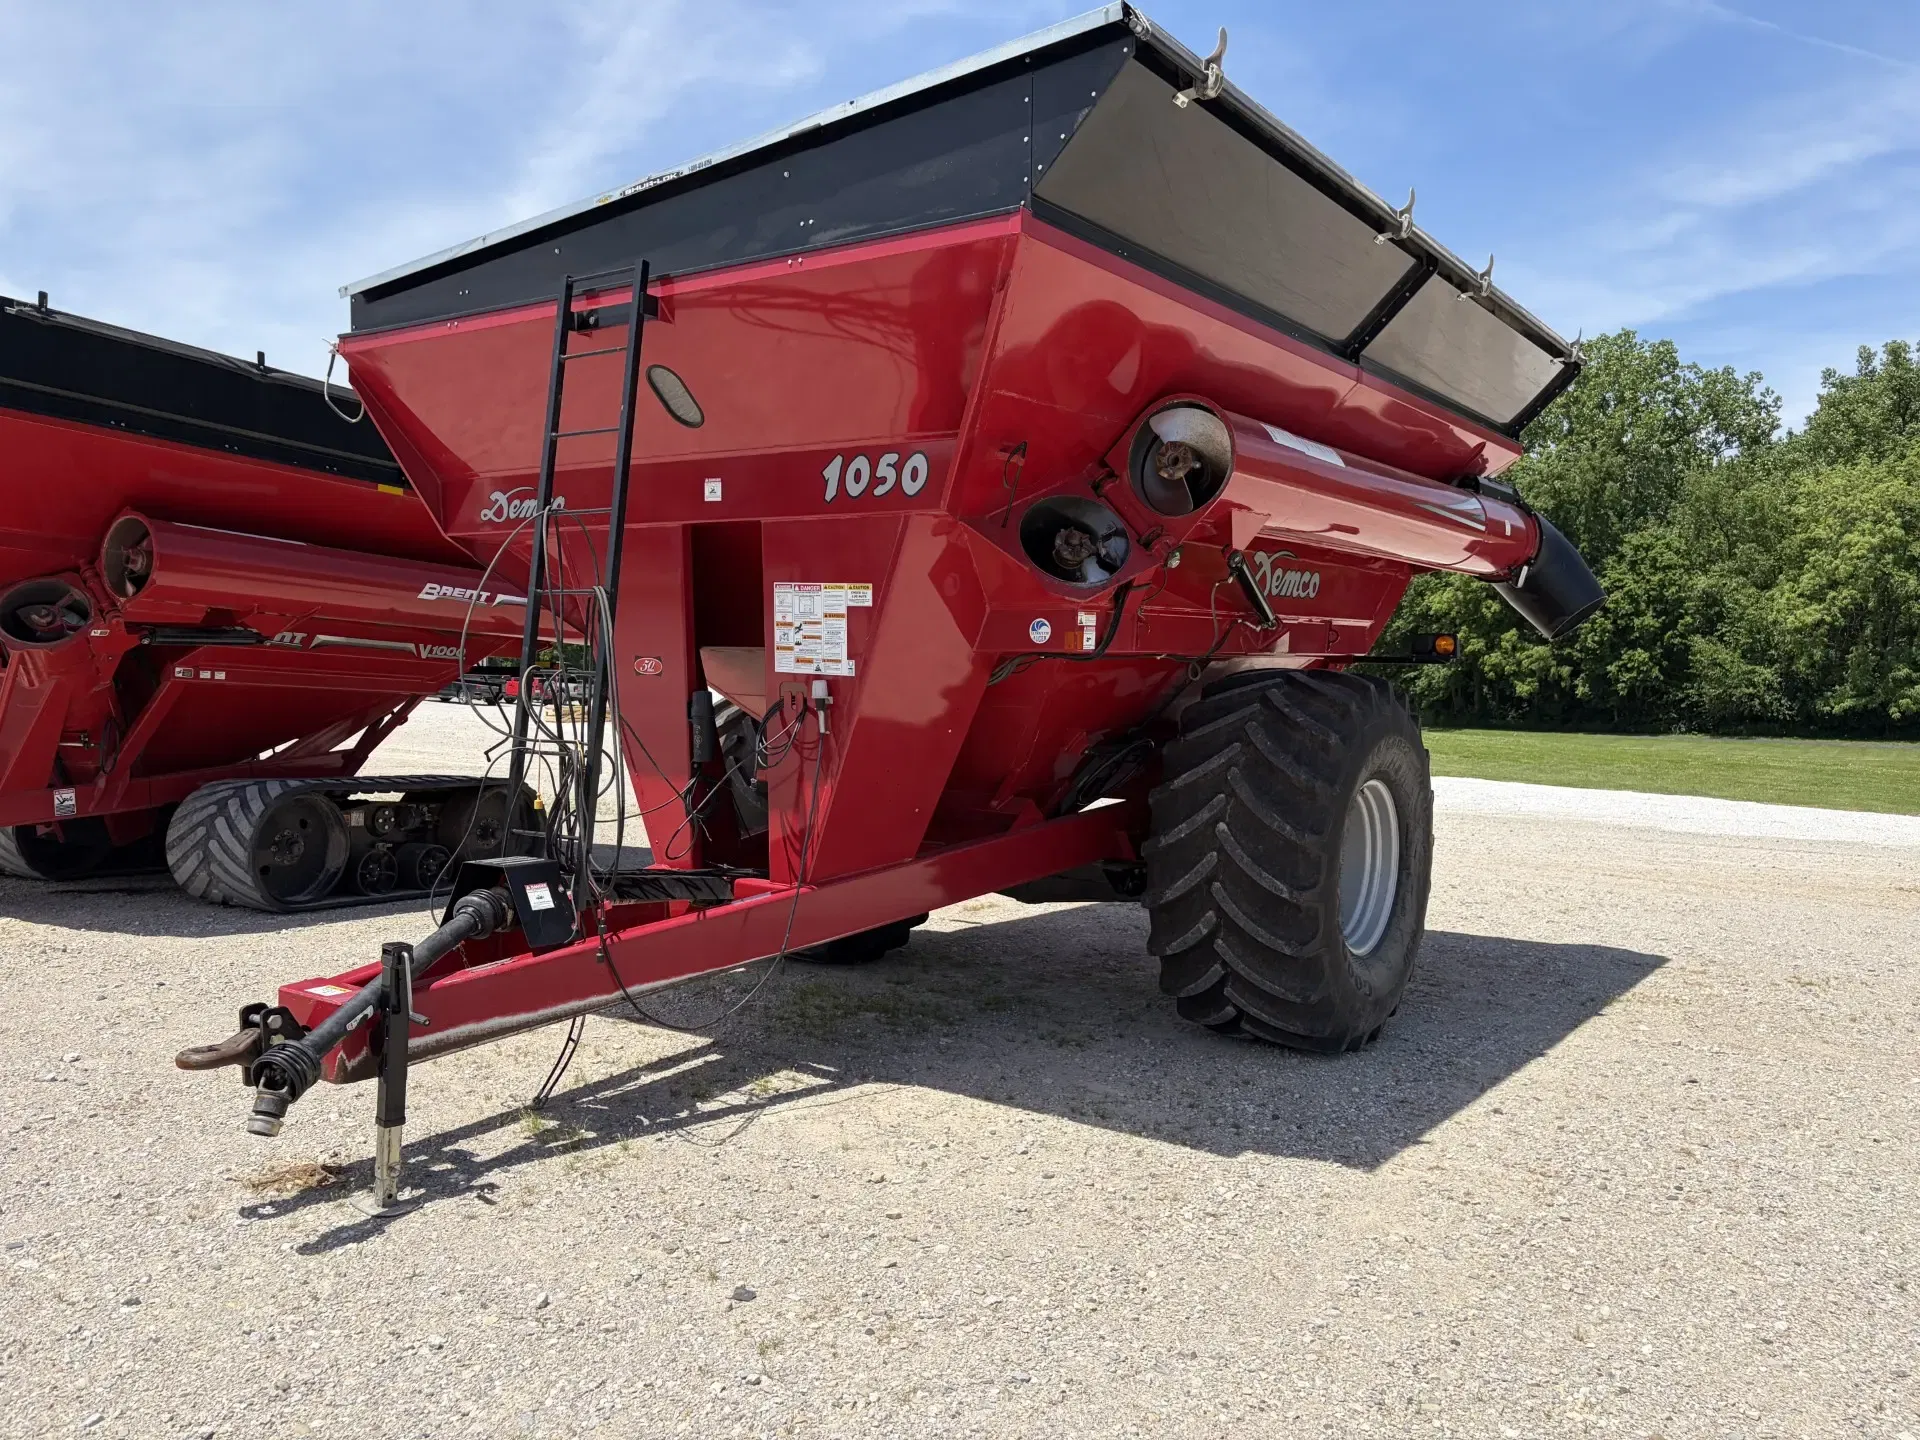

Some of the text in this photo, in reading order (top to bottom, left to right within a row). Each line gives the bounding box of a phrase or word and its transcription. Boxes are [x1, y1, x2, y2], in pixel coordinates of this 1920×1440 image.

[821, 451, 928, 503] 1050
[480, 487, 566, 523] Demo
[417, 582, 491, 605] BRENT
